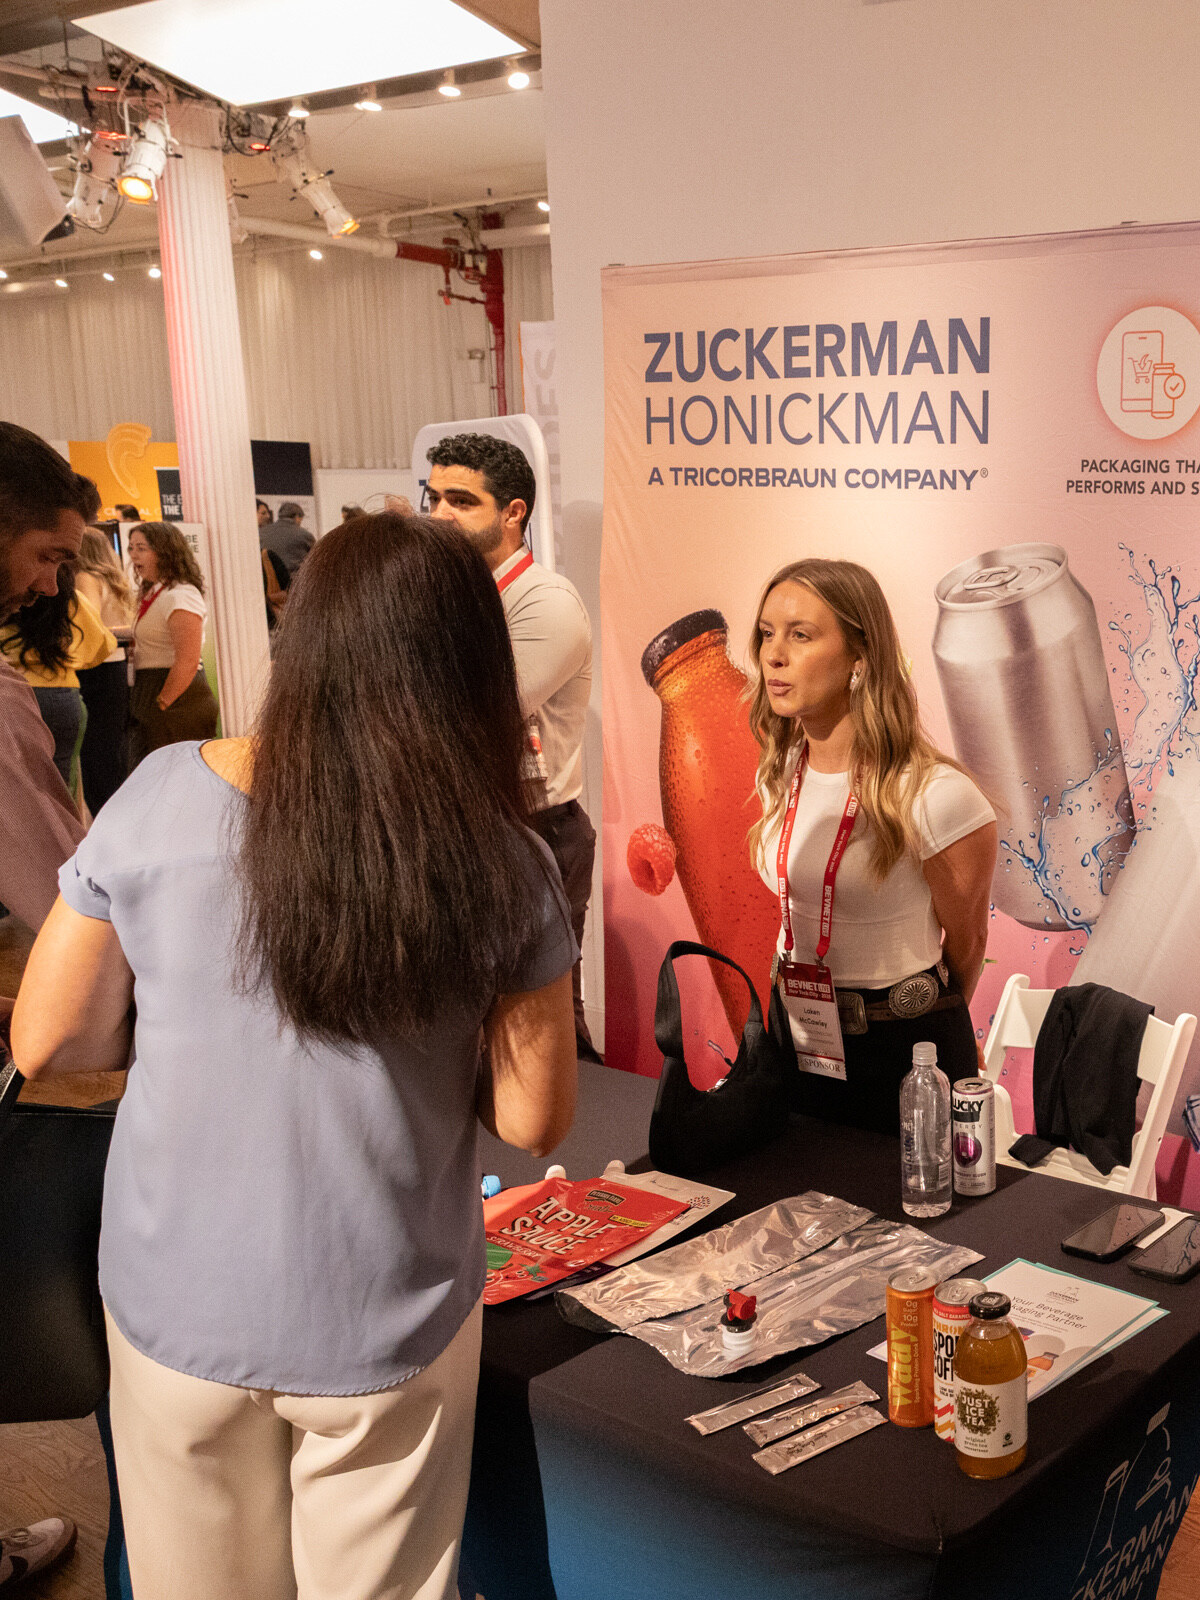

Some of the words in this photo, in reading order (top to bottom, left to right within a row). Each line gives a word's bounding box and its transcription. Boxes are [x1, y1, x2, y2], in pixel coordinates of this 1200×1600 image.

[643, 316, 991, 383] ZUCKERMAN
[645, 389, 990, 447] HONICKMAN
[1080, 458, 1171, 475] PACKAGING
[648, 467, 665, 487] A
[669, 466, 837, 489] TRICORBRAUN
[1066, 479, 1146, 496] PERFORMS
[1150, 480, 1186, 496] AND
[846, 801, 858, 817] LIVE
[823, 886, 832, 923] BEVNET
[805, 1057, 841, 1072] SPONSOR
[953, 1098, 984, 1112] UCKY
[528, 1196, 617, 1241] APPLE
[500, 1216, 587, 1255] SAUCE
[486, 1236, 542, 1259] STRAWBERRY
[1012, 1296, 1034, 1306] Your
[903, 1314, 918, 1322] 10g
[1011, 1303, 1044, 1318] kaging
[1046, 1314, 1088, 1329] Partner
[1035, 1303, 1084, 1320] Beverage
[934, 1328, 959, 1358] SPO
[961, 1395, 990, 1408] JUST
[966, 1406, 985, 1417] ICE
[965, 1415, 985, 1426] TEA
